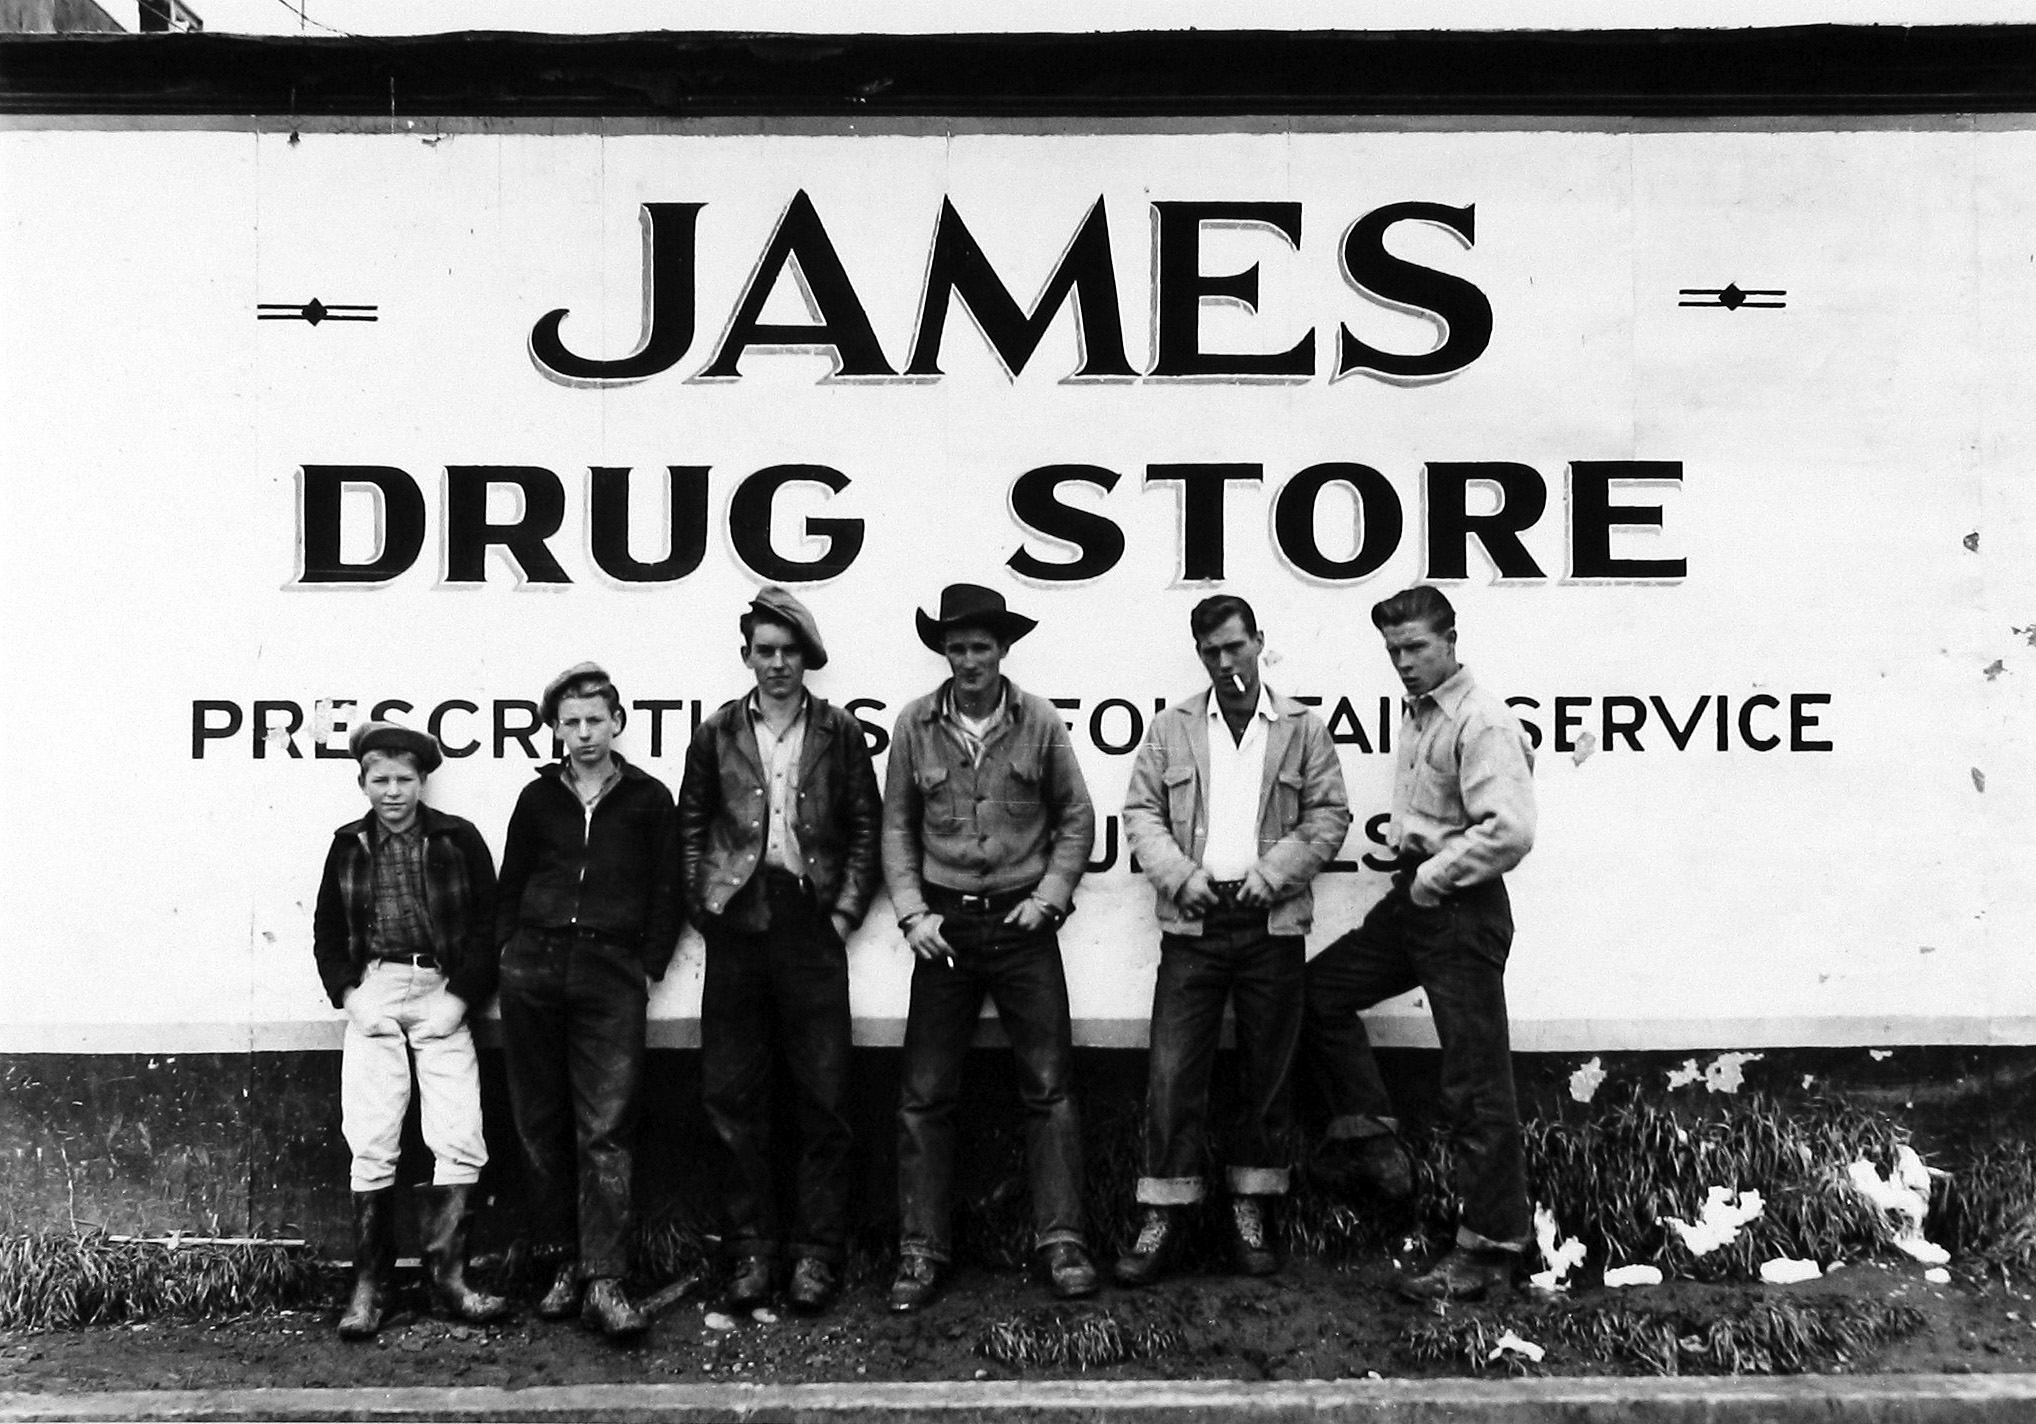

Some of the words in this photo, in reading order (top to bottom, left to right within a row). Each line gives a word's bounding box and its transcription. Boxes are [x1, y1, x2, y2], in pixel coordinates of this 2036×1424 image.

[529, 188, 1495, 386] JAMES
[284, 463, 866, 587] DRUG
[1004, 460, 1688, 586] STORE
